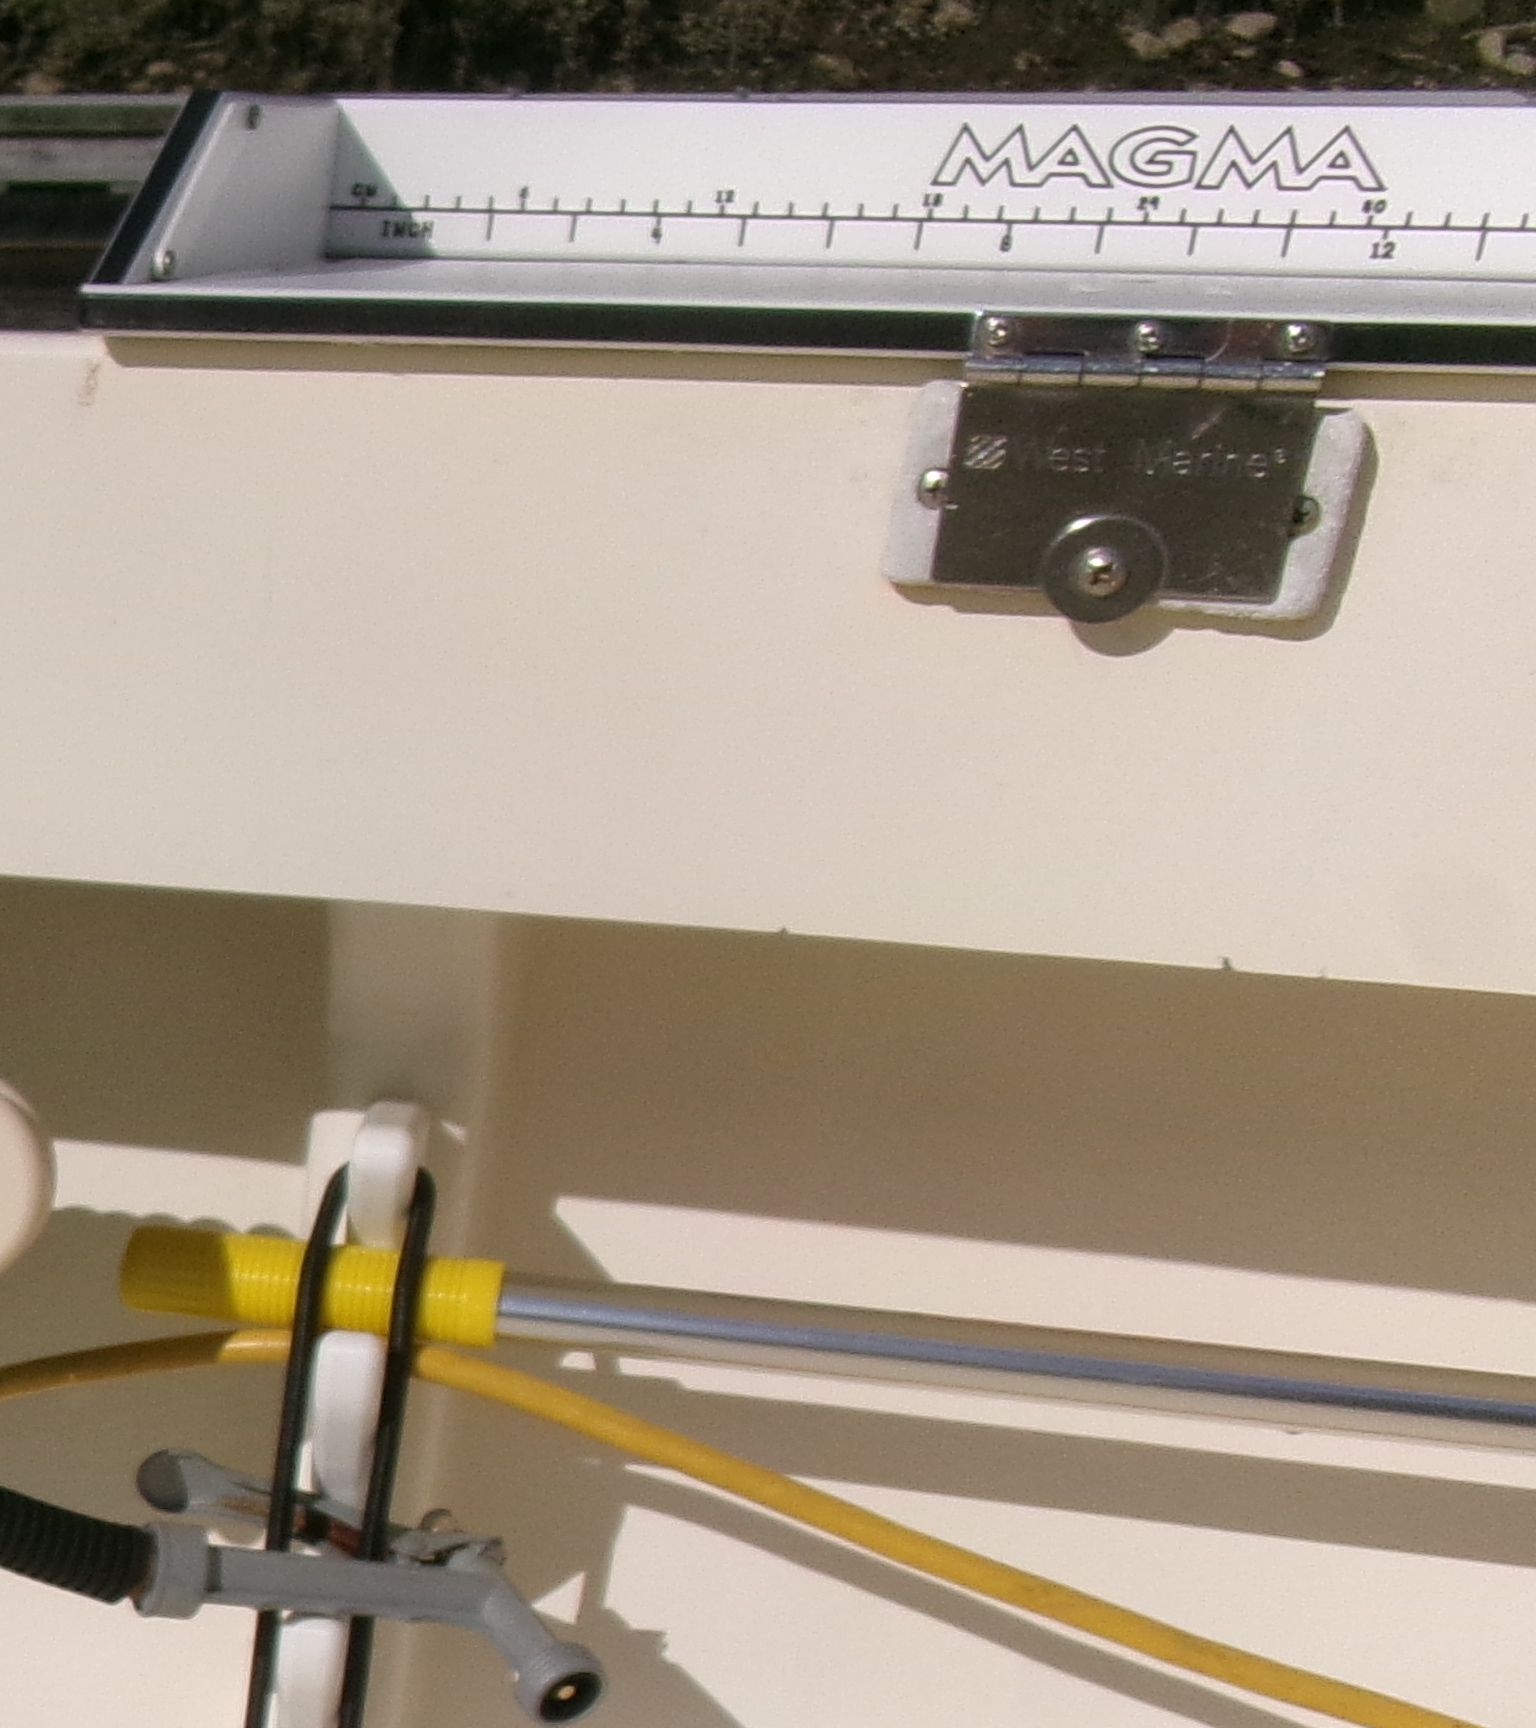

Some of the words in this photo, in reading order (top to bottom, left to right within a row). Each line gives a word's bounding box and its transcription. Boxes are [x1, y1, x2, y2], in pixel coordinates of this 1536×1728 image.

[933, 122, 1387, 190] MAGMA
[383, 221, 435, 239] INCH
[1369, 241, 1395, 260] 12
